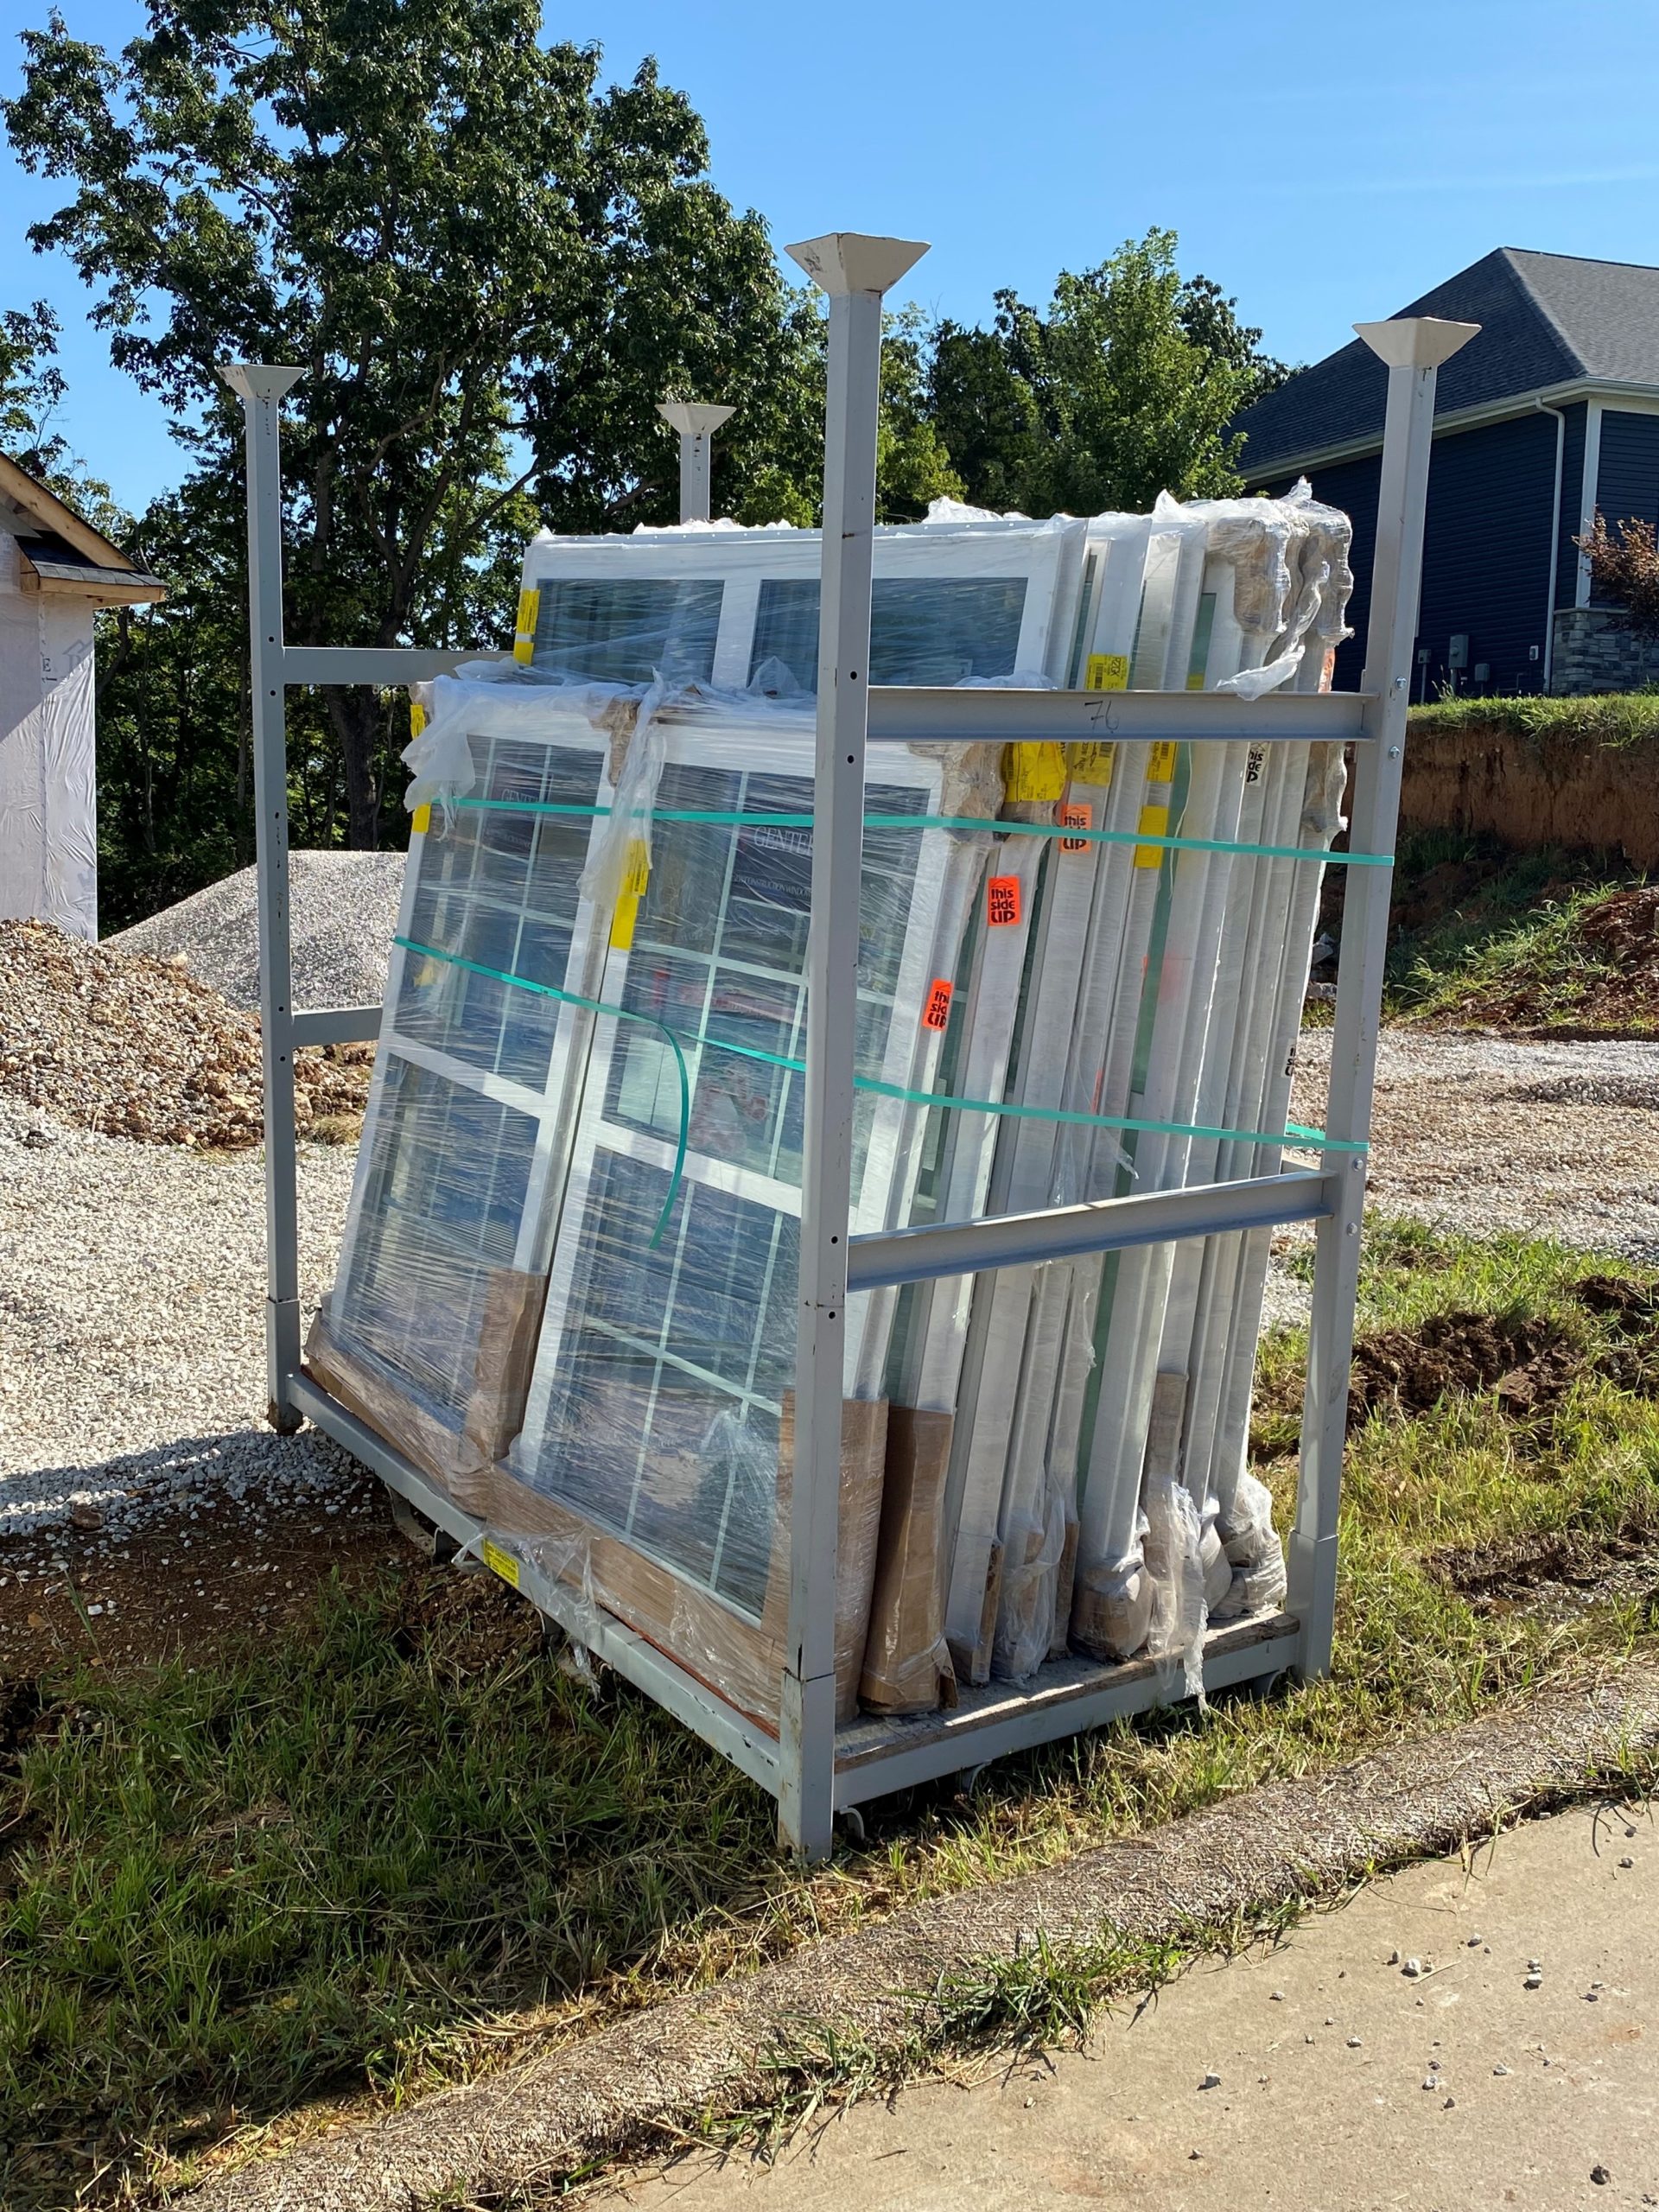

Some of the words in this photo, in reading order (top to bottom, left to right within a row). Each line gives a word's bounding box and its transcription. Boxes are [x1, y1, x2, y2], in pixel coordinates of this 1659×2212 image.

[1249, 749, 1263, 761] his
[1248, 760, 1262, 772] de
[1246, 771, 1259, 783] P
[1064, 815, 1086, 826] this
[1063, 837, 1087, 850] UP
[991, 888, 1014, 899] this
[990, 899, 1015, 910] side
[990, 910, 1016, 924] UP
[930, 1001, 947, 1014] sid
[927, 1012, 947, 1028] UP
